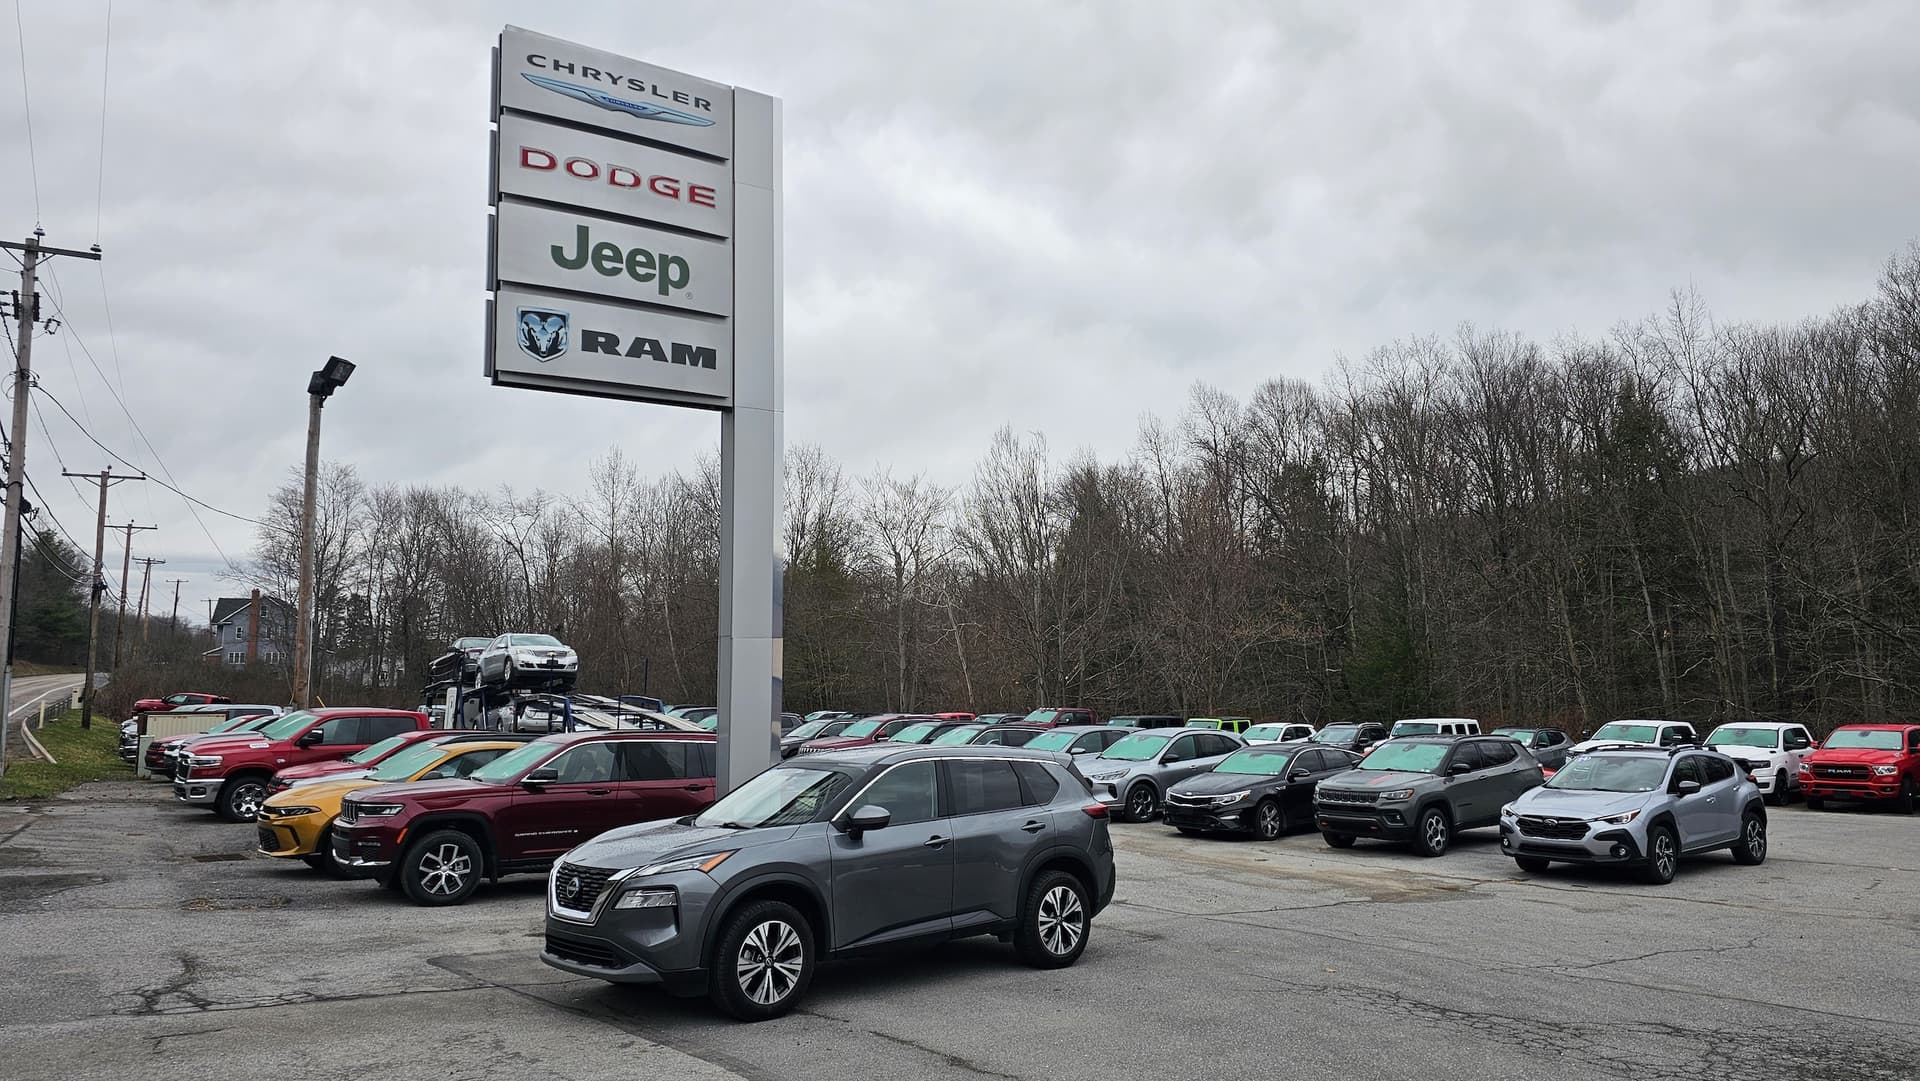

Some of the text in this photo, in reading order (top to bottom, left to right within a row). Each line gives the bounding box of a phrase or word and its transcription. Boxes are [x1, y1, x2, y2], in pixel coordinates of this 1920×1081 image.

[526, 54, 712, 112] CHRYSLER
[519, 146, 717, 209] DODGE
[550, 224, 690, 297] Jeep
[580, 328, 717, 370] RAM
